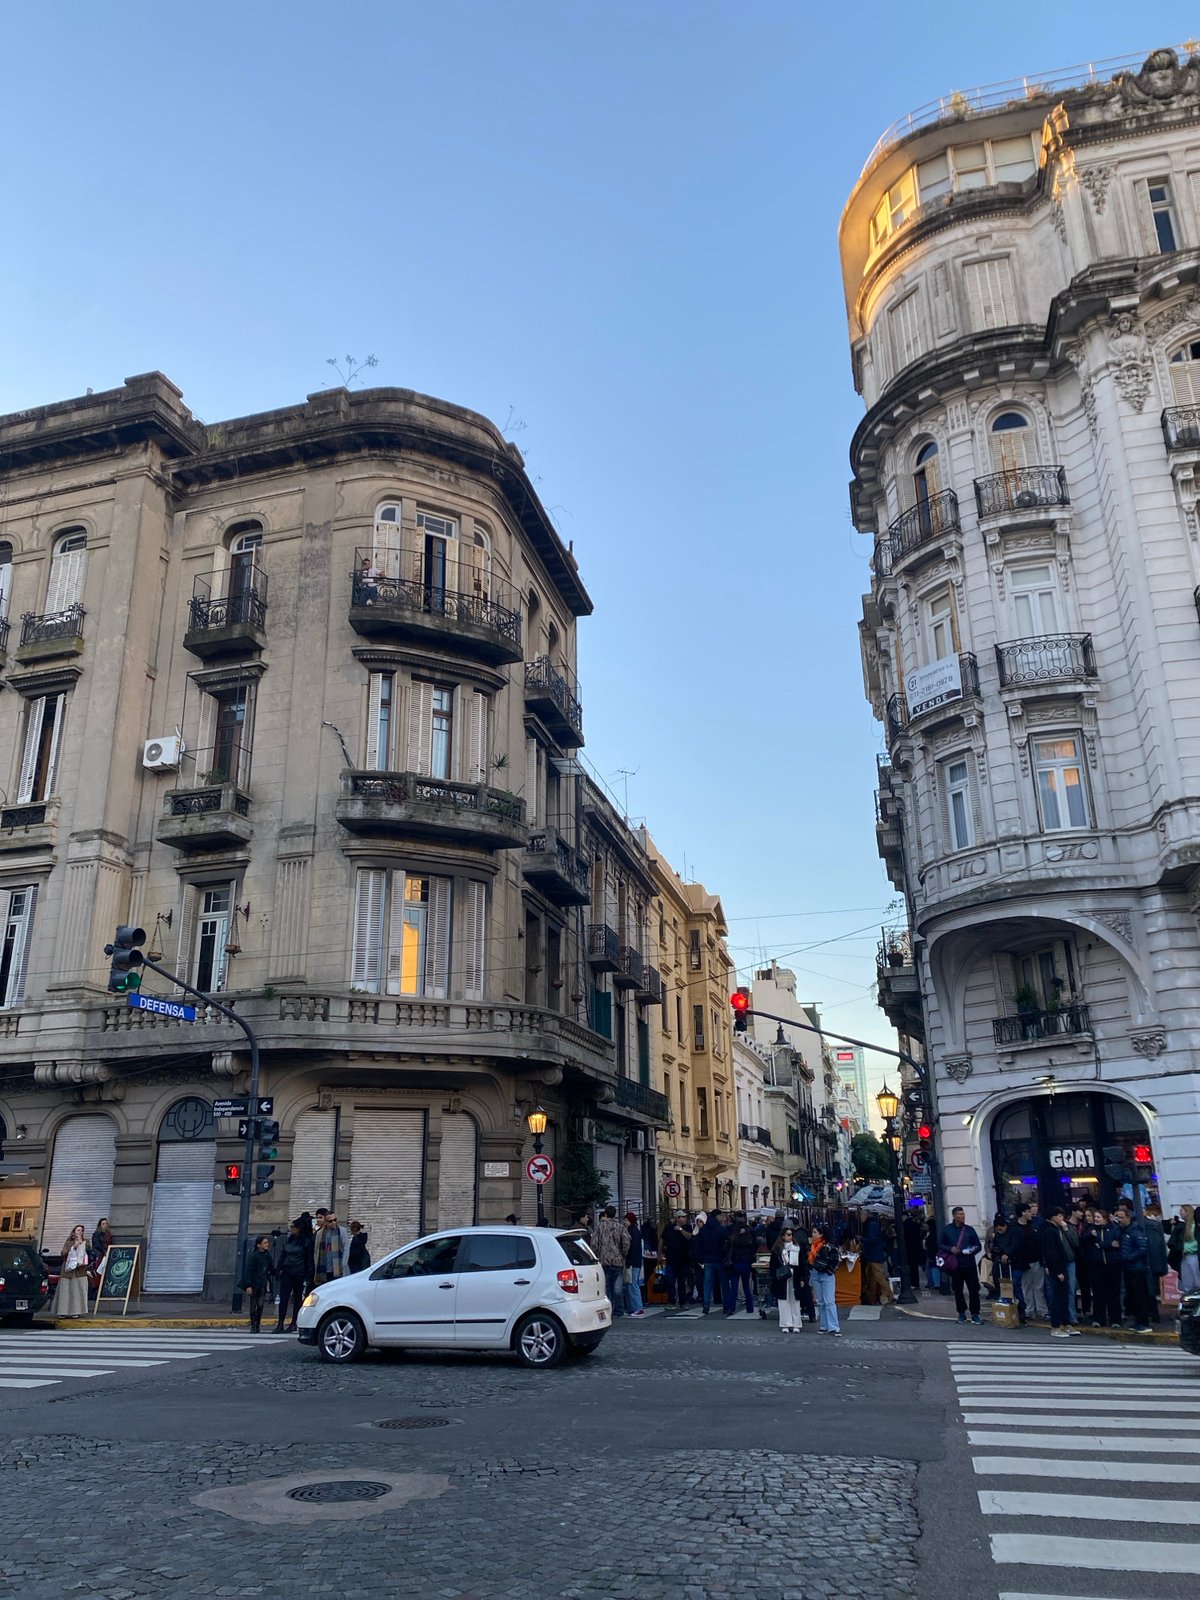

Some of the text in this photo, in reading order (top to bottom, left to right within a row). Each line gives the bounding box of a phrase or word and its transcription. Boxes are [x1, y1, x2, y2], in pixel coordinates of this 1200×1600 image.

[915, 693, 948, 712] VENDE
[139, 996, 185, 1019] DEFENSA
[1049, 1148, 1095, 1169] GOAT
